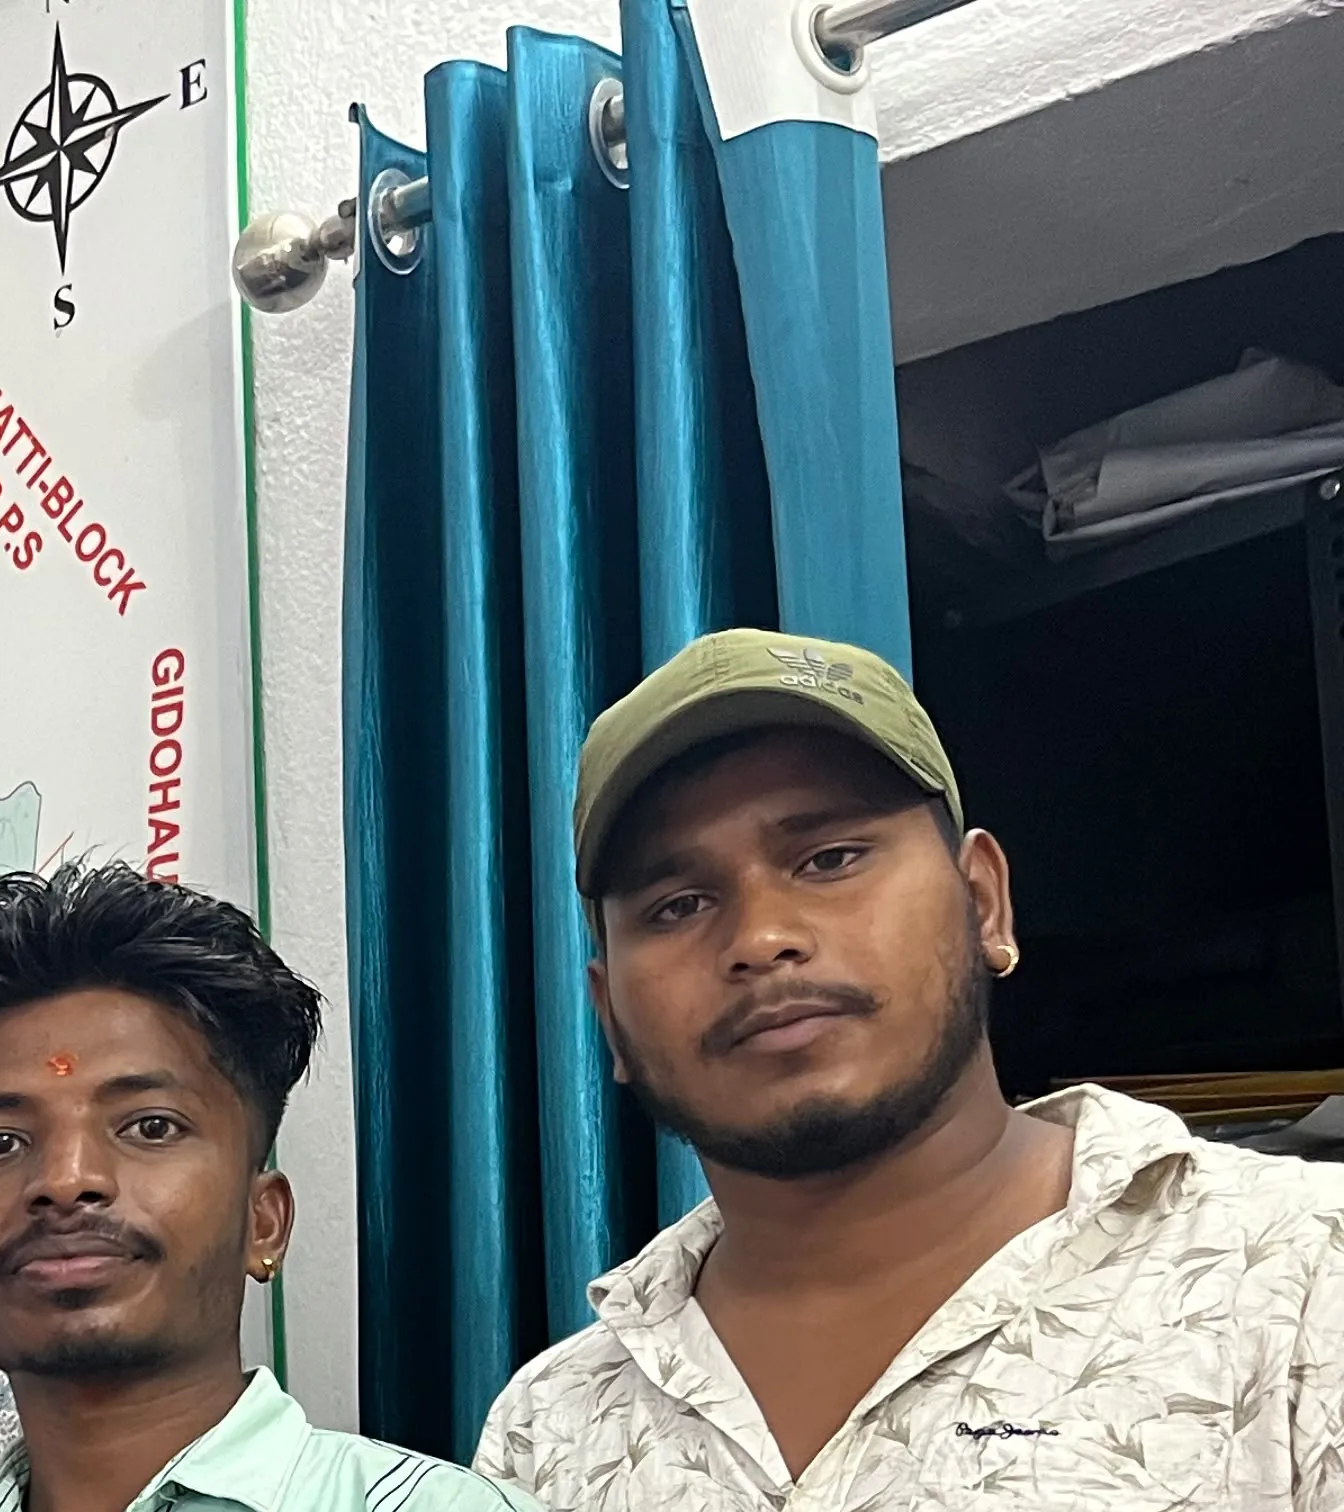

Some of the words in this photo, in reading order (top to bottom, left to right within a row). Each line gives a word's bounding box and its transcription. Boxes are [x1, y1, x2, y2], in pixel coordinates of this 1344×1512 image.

[178, 58, 208, 110] E
[52, 283, 75, 330] S
[148, 648, 184, 882] GIDOHAU
